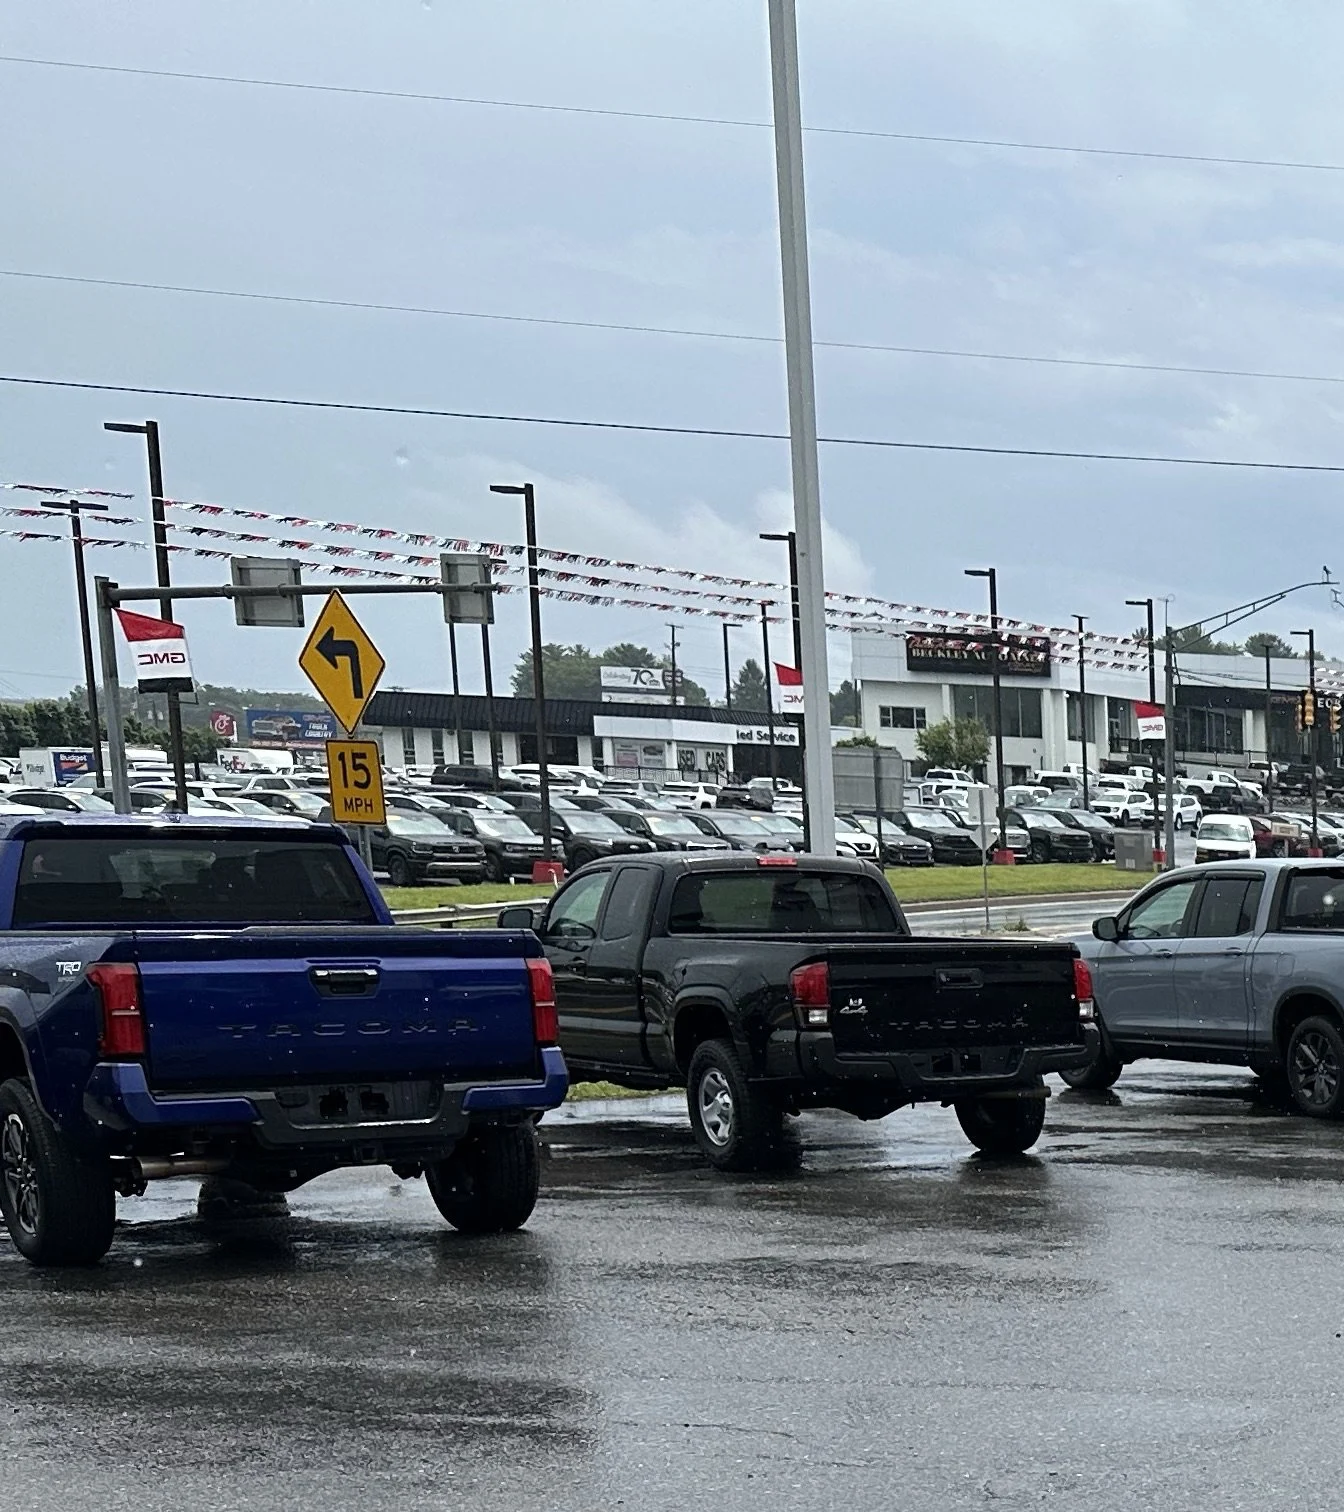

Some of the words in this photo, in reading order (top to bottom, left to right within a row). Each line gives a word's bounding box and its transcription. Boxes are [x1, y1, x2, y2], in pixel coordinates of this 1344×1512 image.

[911, 648, 969, 660] BECKLEY
[757, 731, 796, 743] Sevice
[338, 752, 371, 790] 15
[344, 797, 373, 813] MPH
[56, 961, 81, 975] TRD
[217, 1019, 481, 1039] TACOMA
